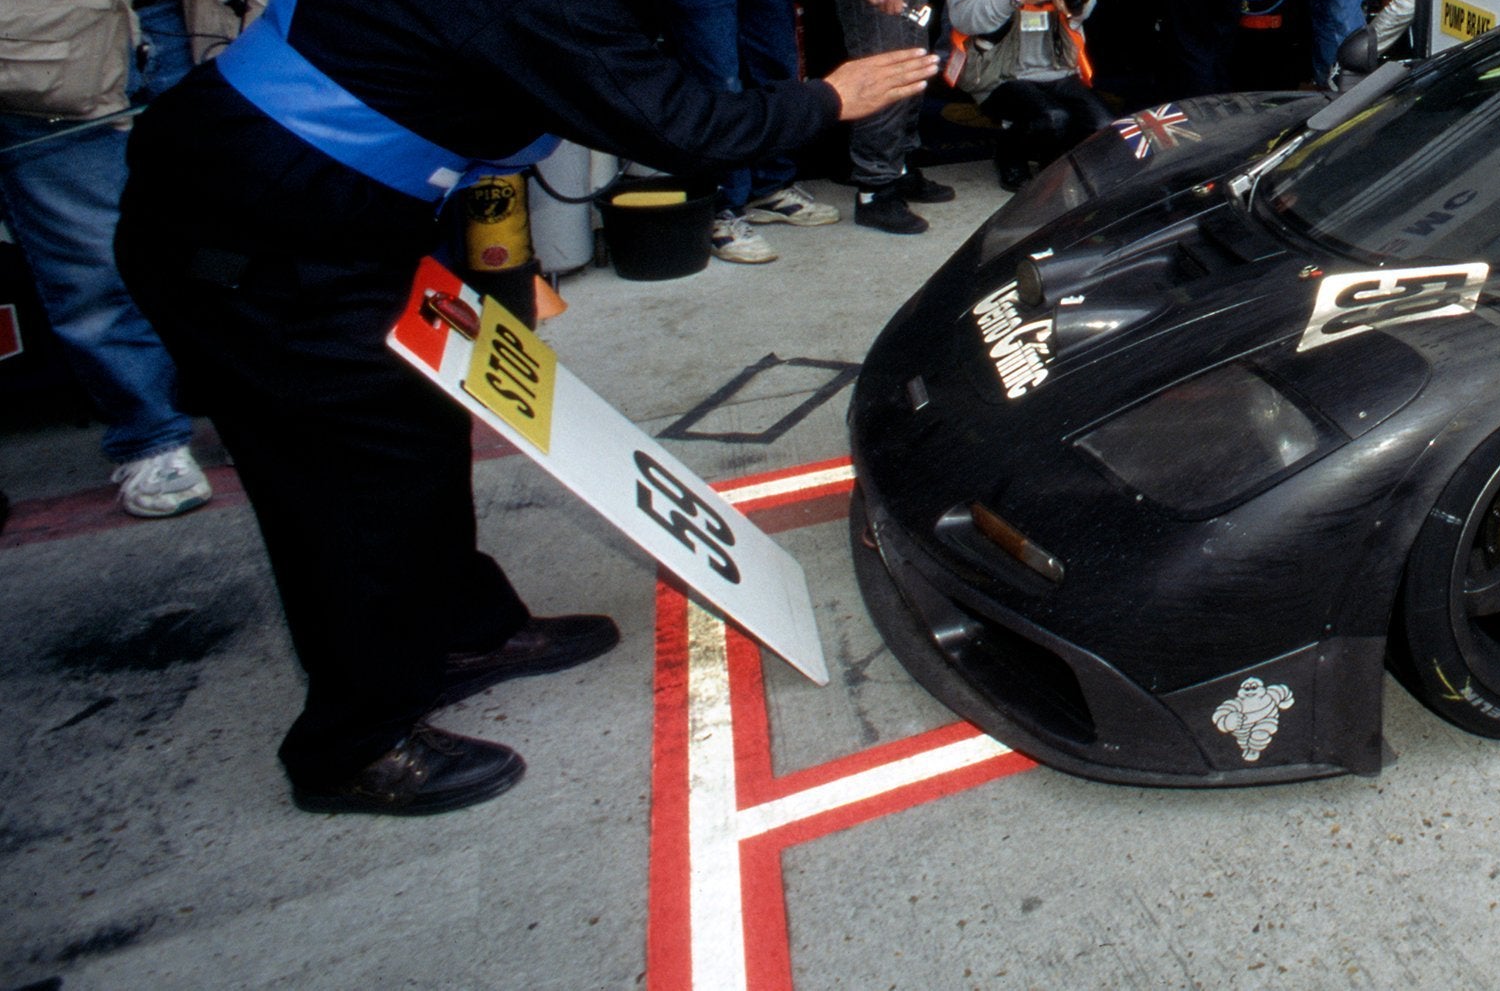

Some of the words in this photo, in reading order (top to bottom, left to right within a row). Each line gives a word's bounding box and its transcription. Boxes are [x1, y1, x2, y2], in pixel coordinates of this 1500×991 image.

[1445, 2, 1466, 32] PUMP
[1466, 10, 1491, 39] BRAKE
[485, 323, 540, 420] STOP
[633, 450, 741, 584] 59
